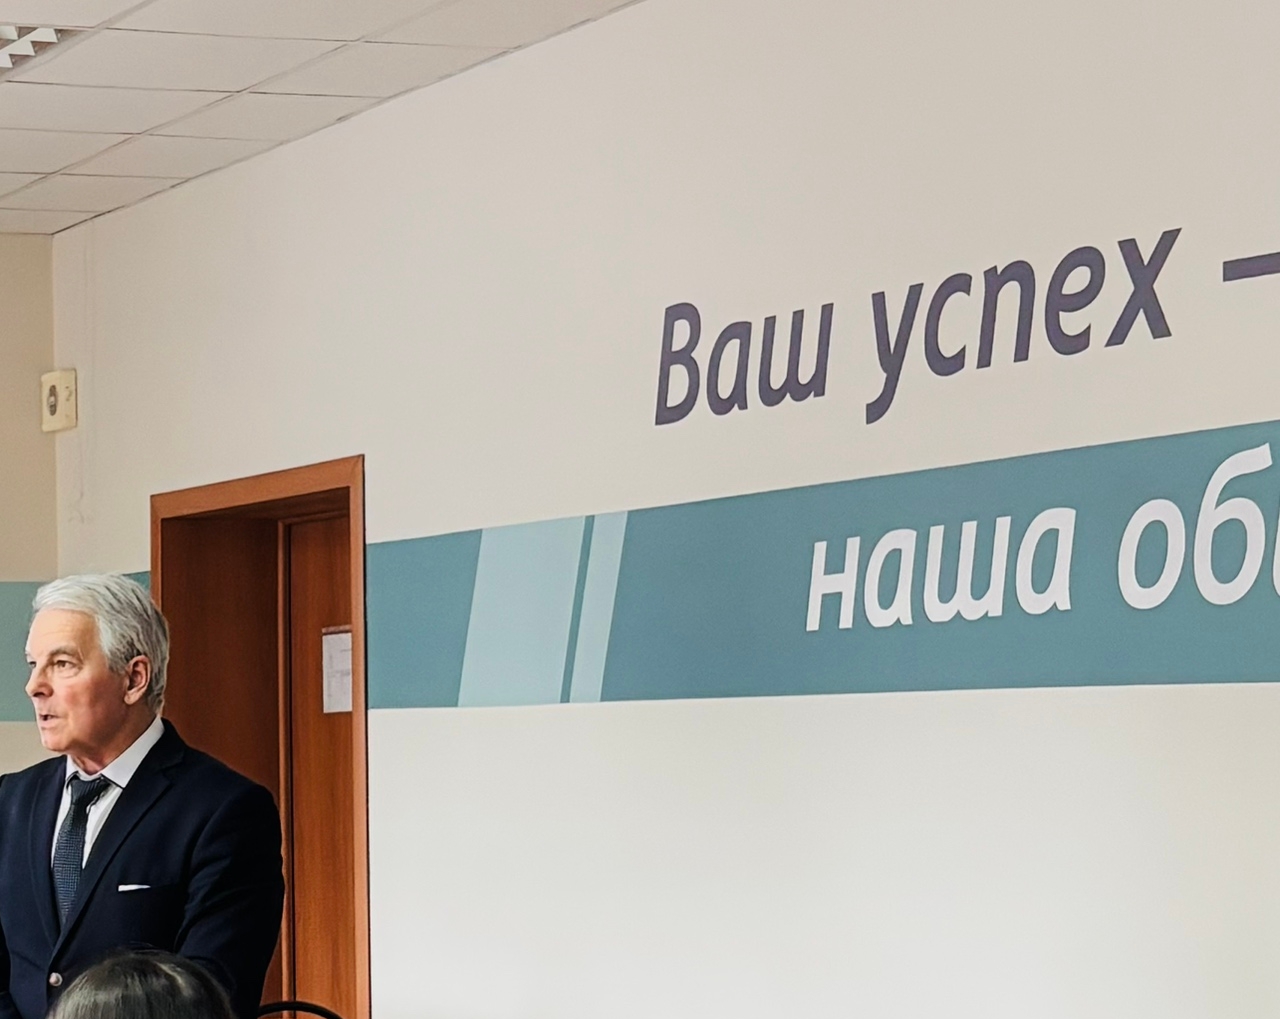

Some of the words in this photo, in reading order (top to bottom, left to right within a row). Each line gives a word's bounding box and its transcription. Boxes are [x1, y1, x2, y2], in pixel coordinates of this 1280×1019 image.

[655, 301, 834, 426] Ваш
[865, 227, 1183, 425] успех
[806, 506, 1077, 632] наша
[1117, 442, 1280, 610] об
